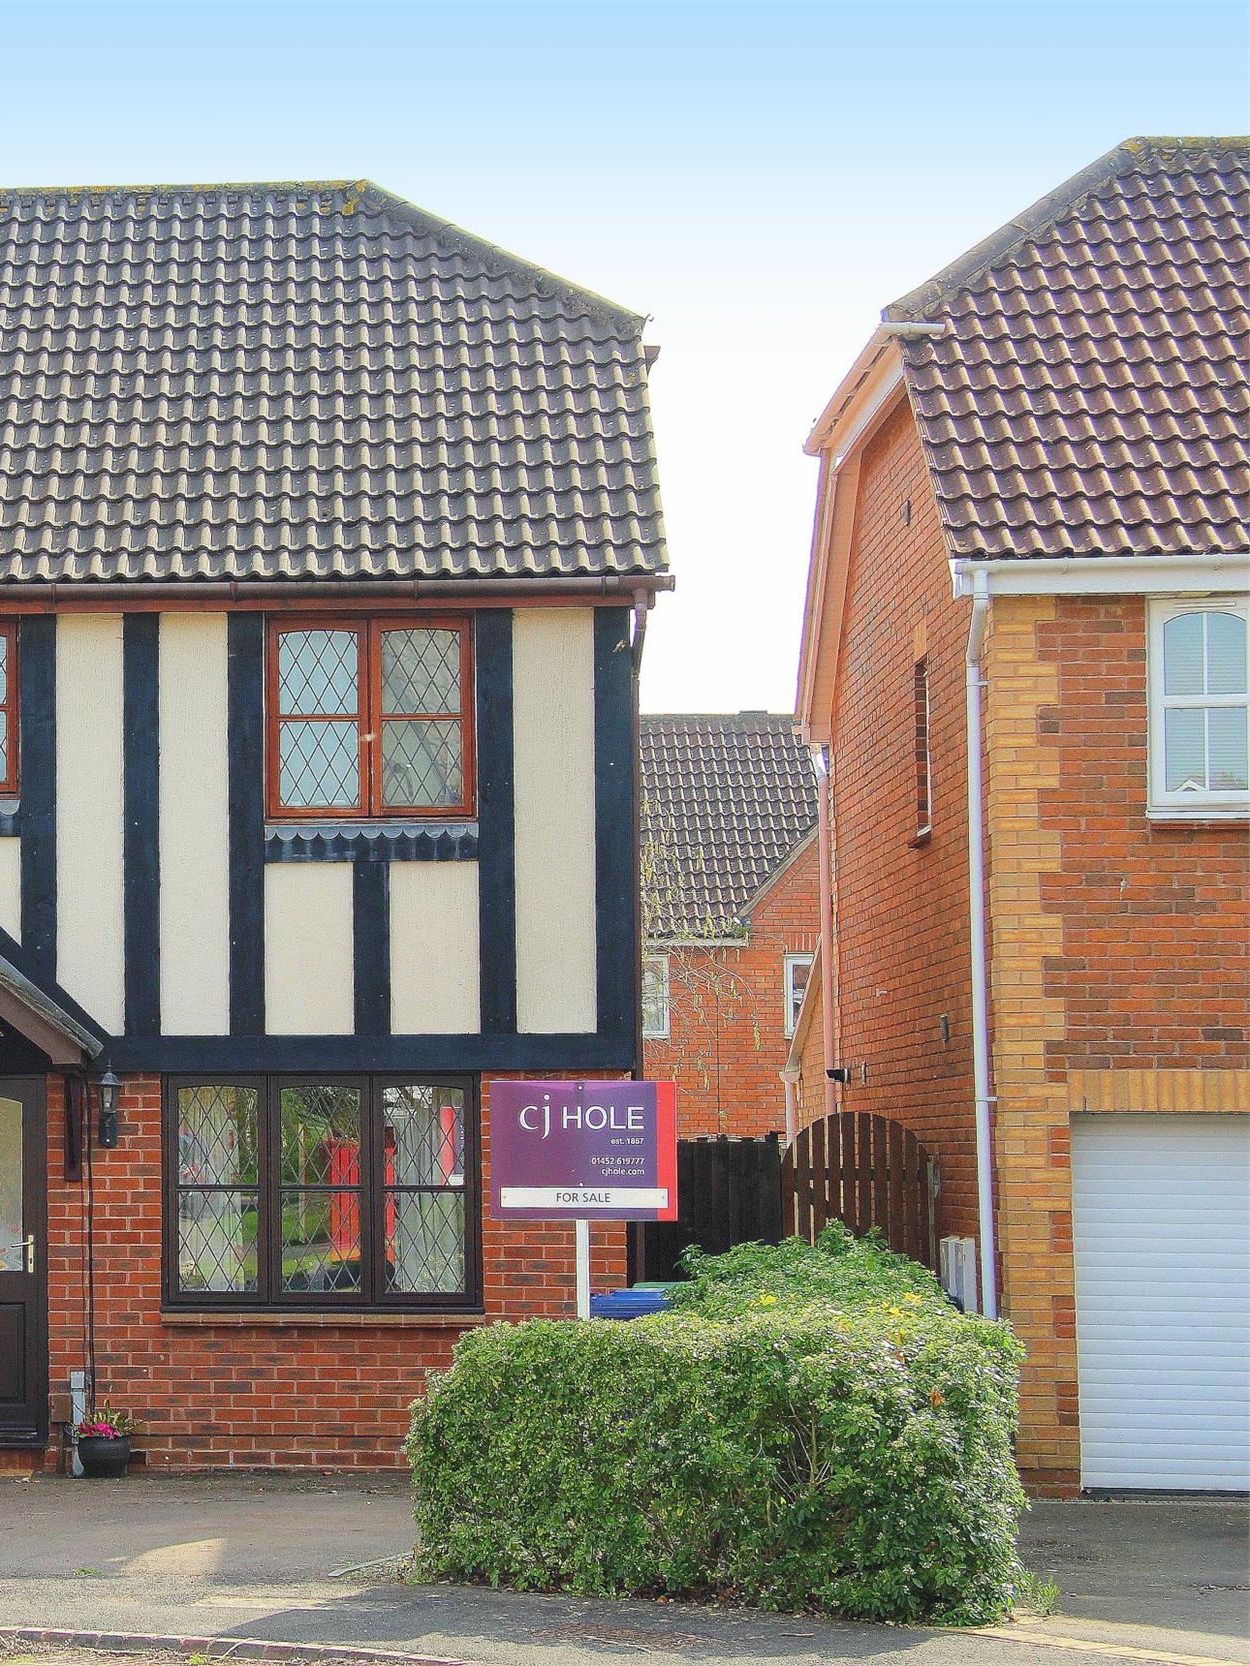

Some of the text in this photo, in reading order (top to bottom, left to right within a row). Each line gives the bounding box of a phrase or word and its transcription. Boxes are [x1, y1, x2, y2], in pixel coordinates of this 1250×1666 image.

[562, 1105, 644, 1129] HOLE
[611, 1137, 625, 1145] est.
[591, 1157, 645, 1165] 01452 619777
[601, 1167, 645, 1177] cjhole.com
[556, 1192, 611, 1203] FOR SALE
